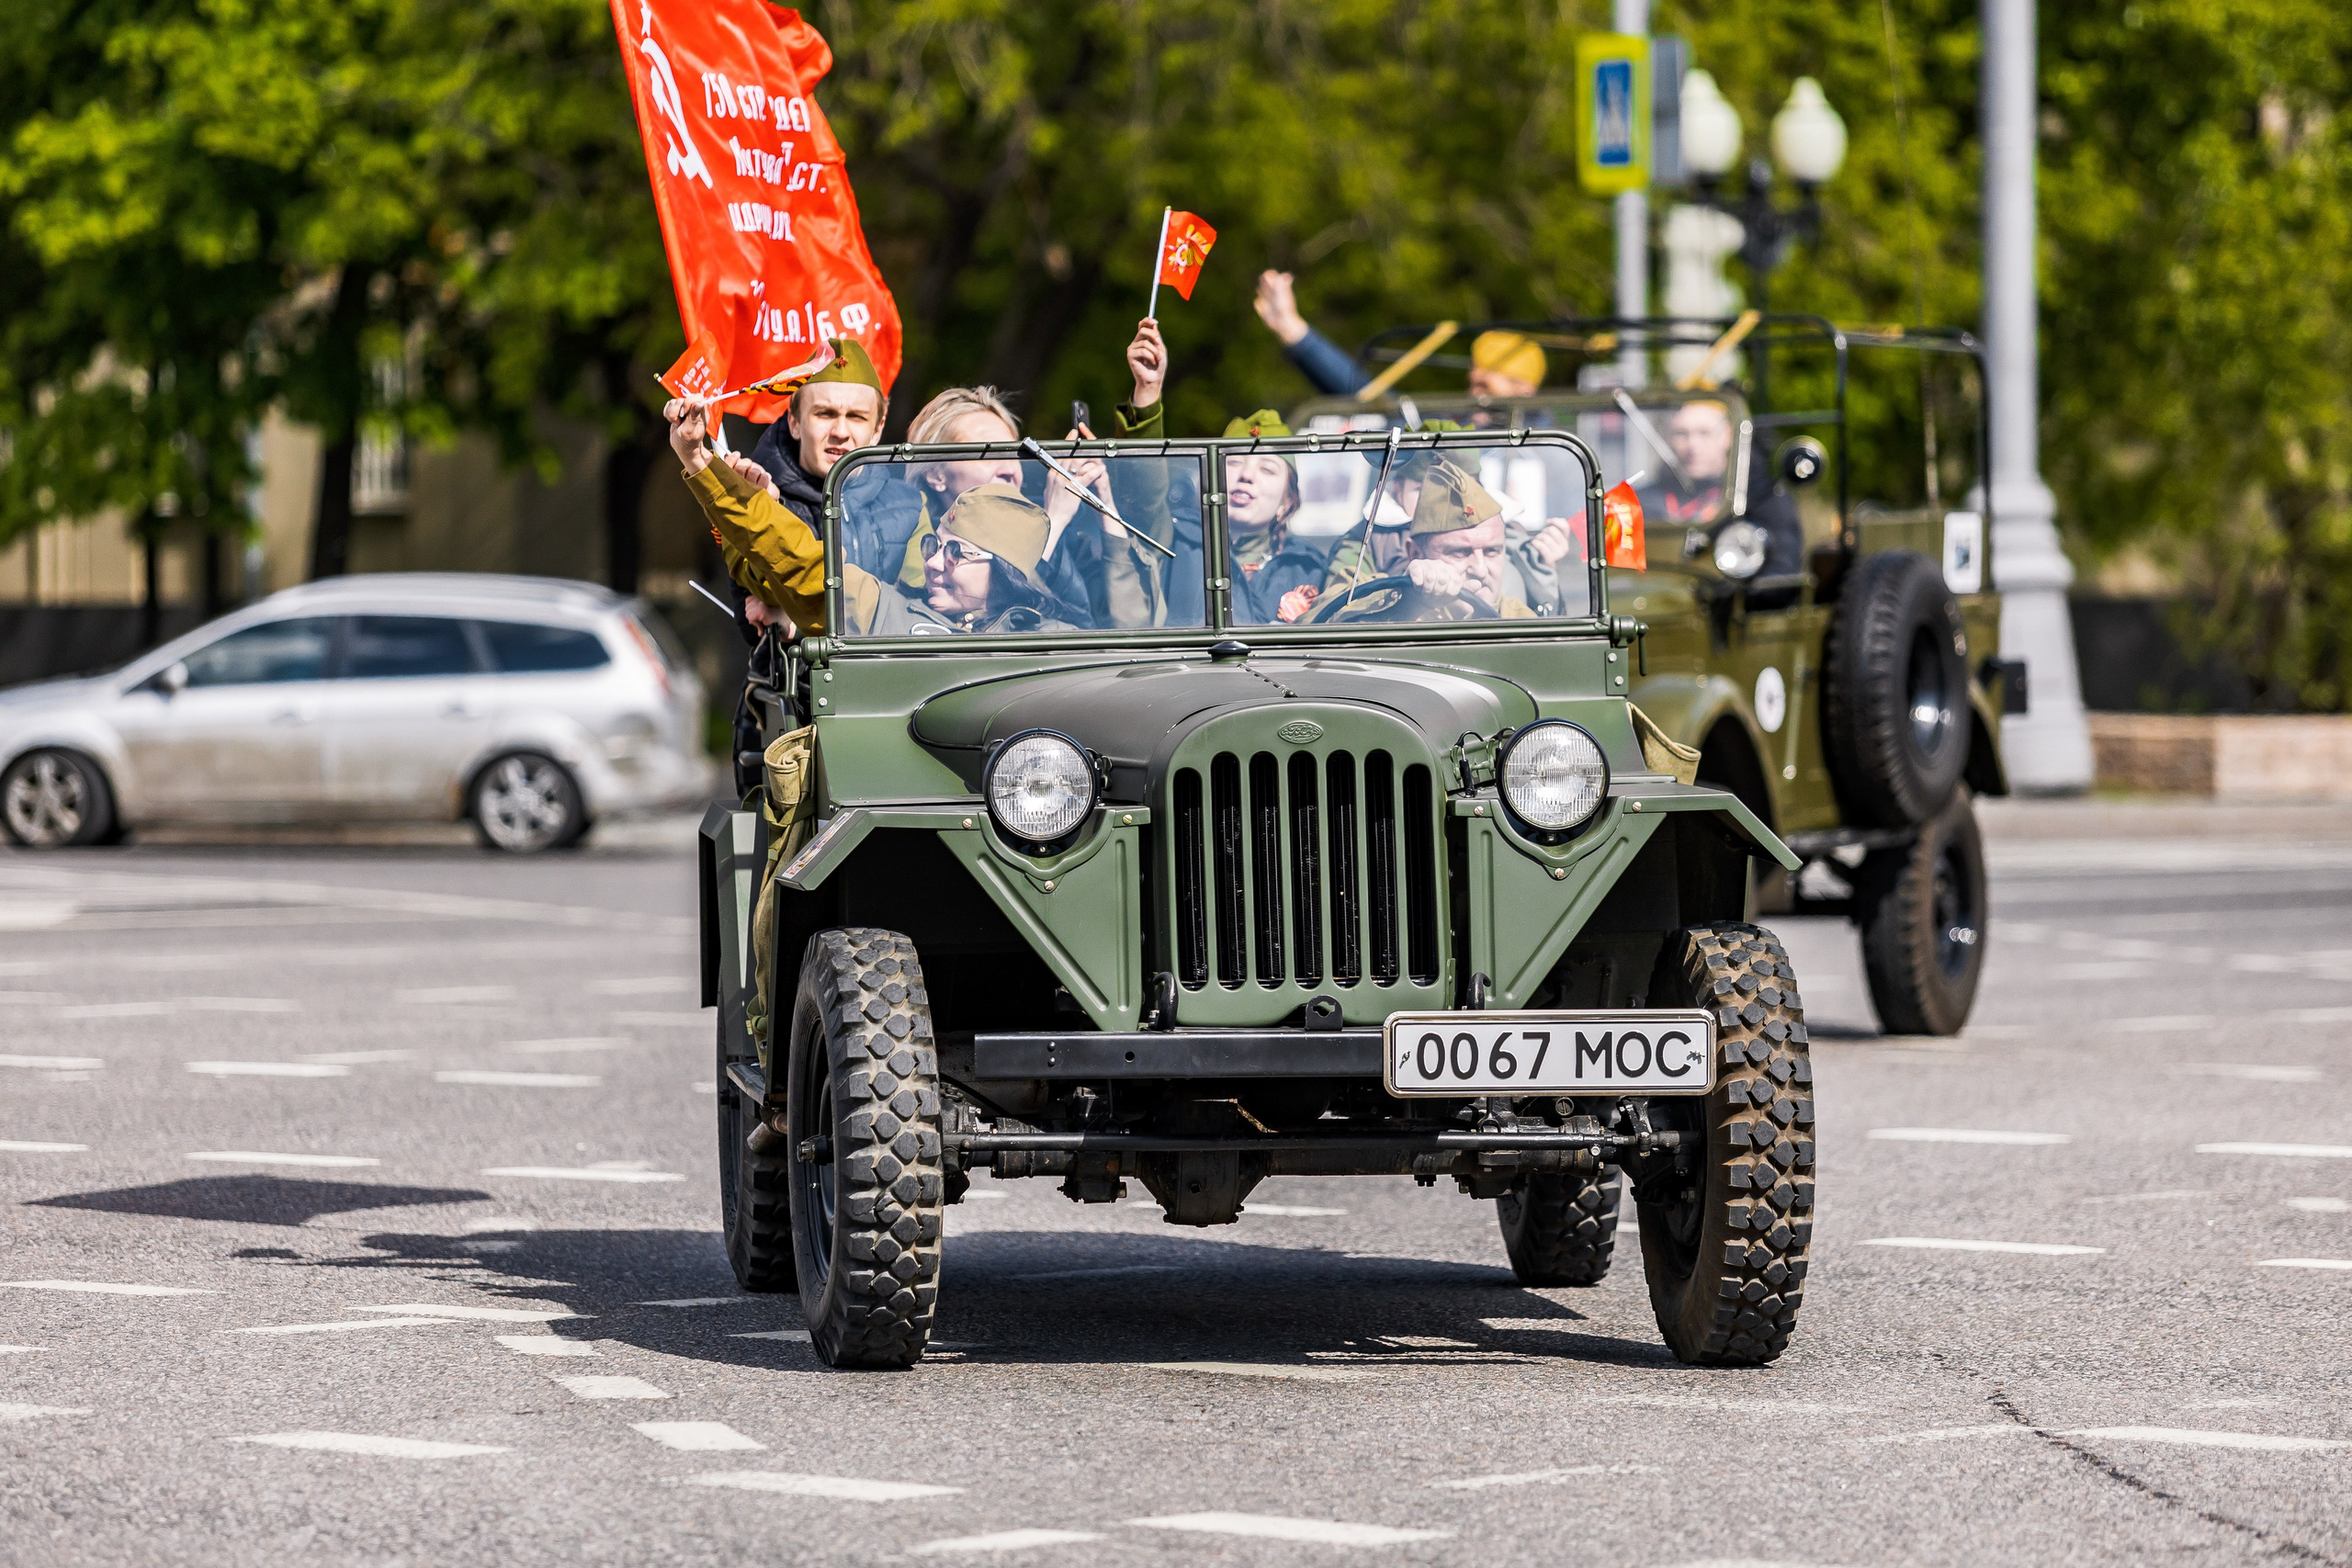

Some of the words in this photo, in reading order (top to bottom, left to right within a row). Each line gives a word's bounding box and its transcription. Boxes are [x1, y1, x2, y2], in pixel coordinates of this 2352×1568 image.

[701, 72, 738, 118] 150
[1416, 1031, 1552, 1080] 0067
[1574, 1030, 1693, 1078] МОС
